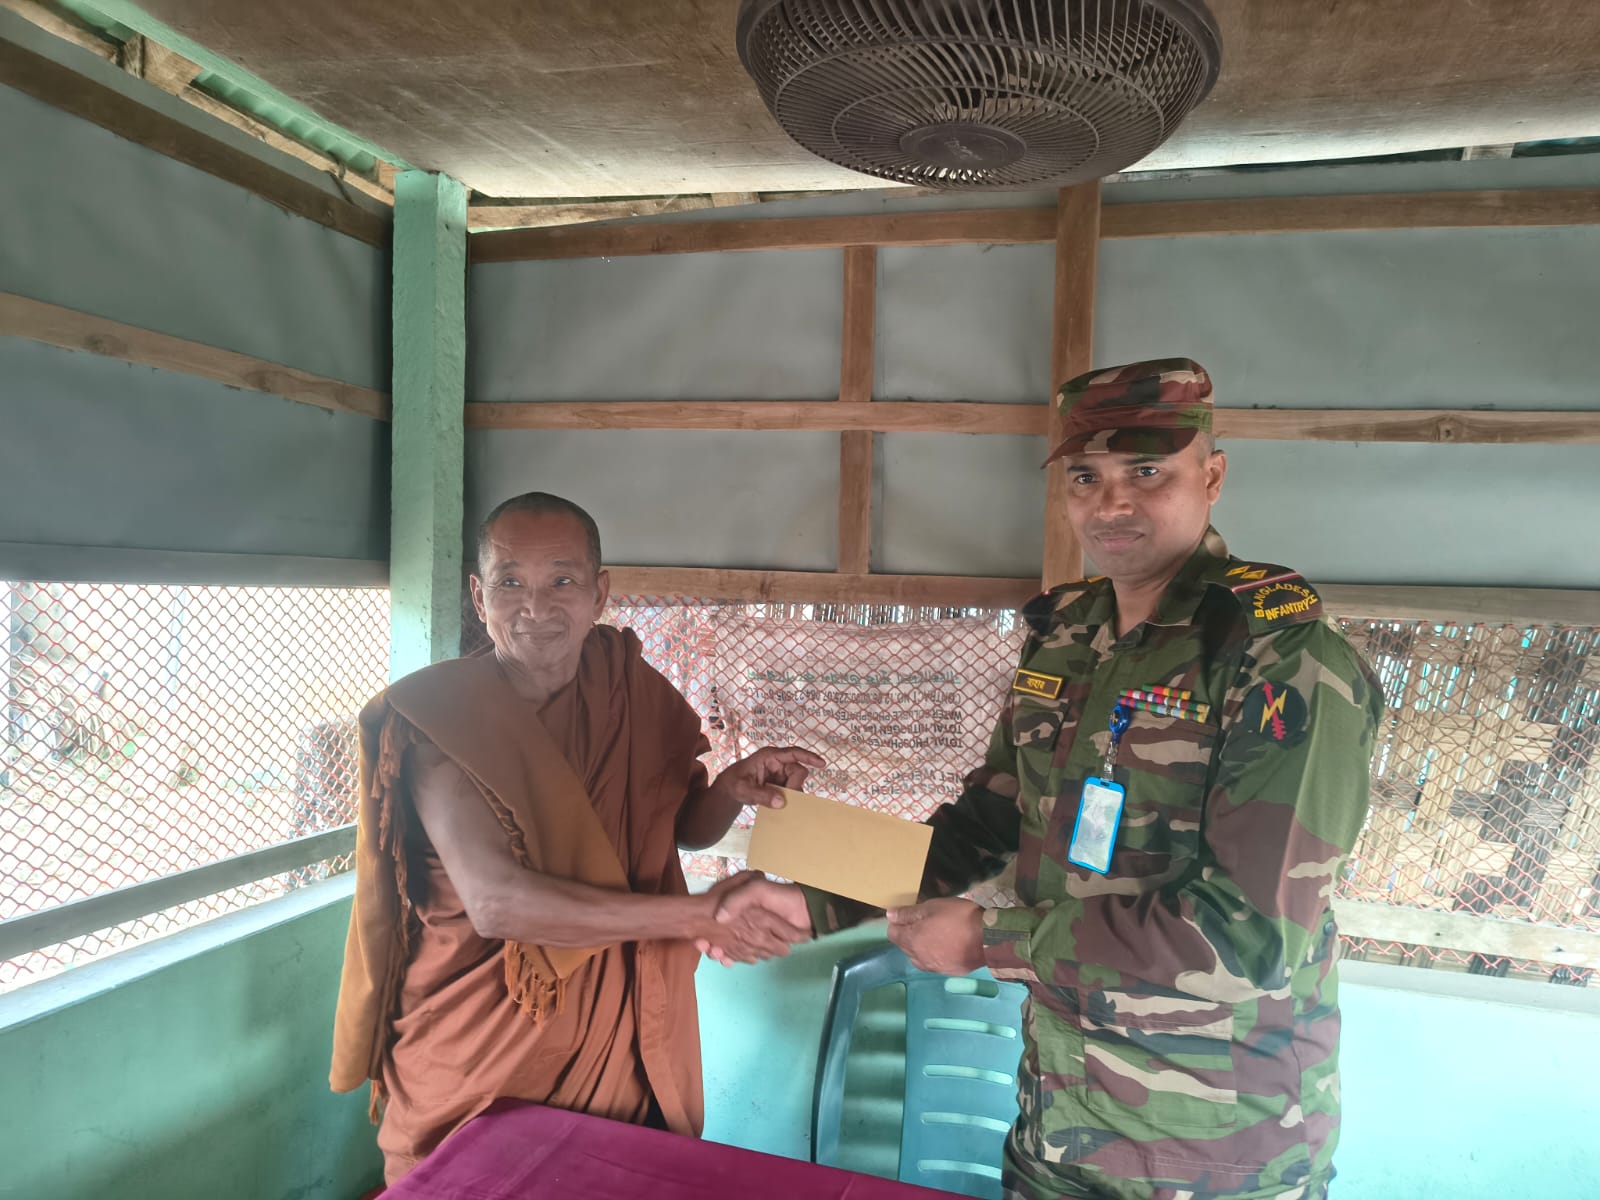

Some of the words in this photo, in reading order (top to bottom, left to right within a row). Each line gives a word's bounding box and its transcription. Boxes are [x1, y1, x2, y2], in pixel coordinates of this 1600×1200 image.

[1252, 583, 1318, 618] BANGLADESH
[1264, 599, 1310, 621] INFANTRY
[930, 723, 963, 735] TOTAL
